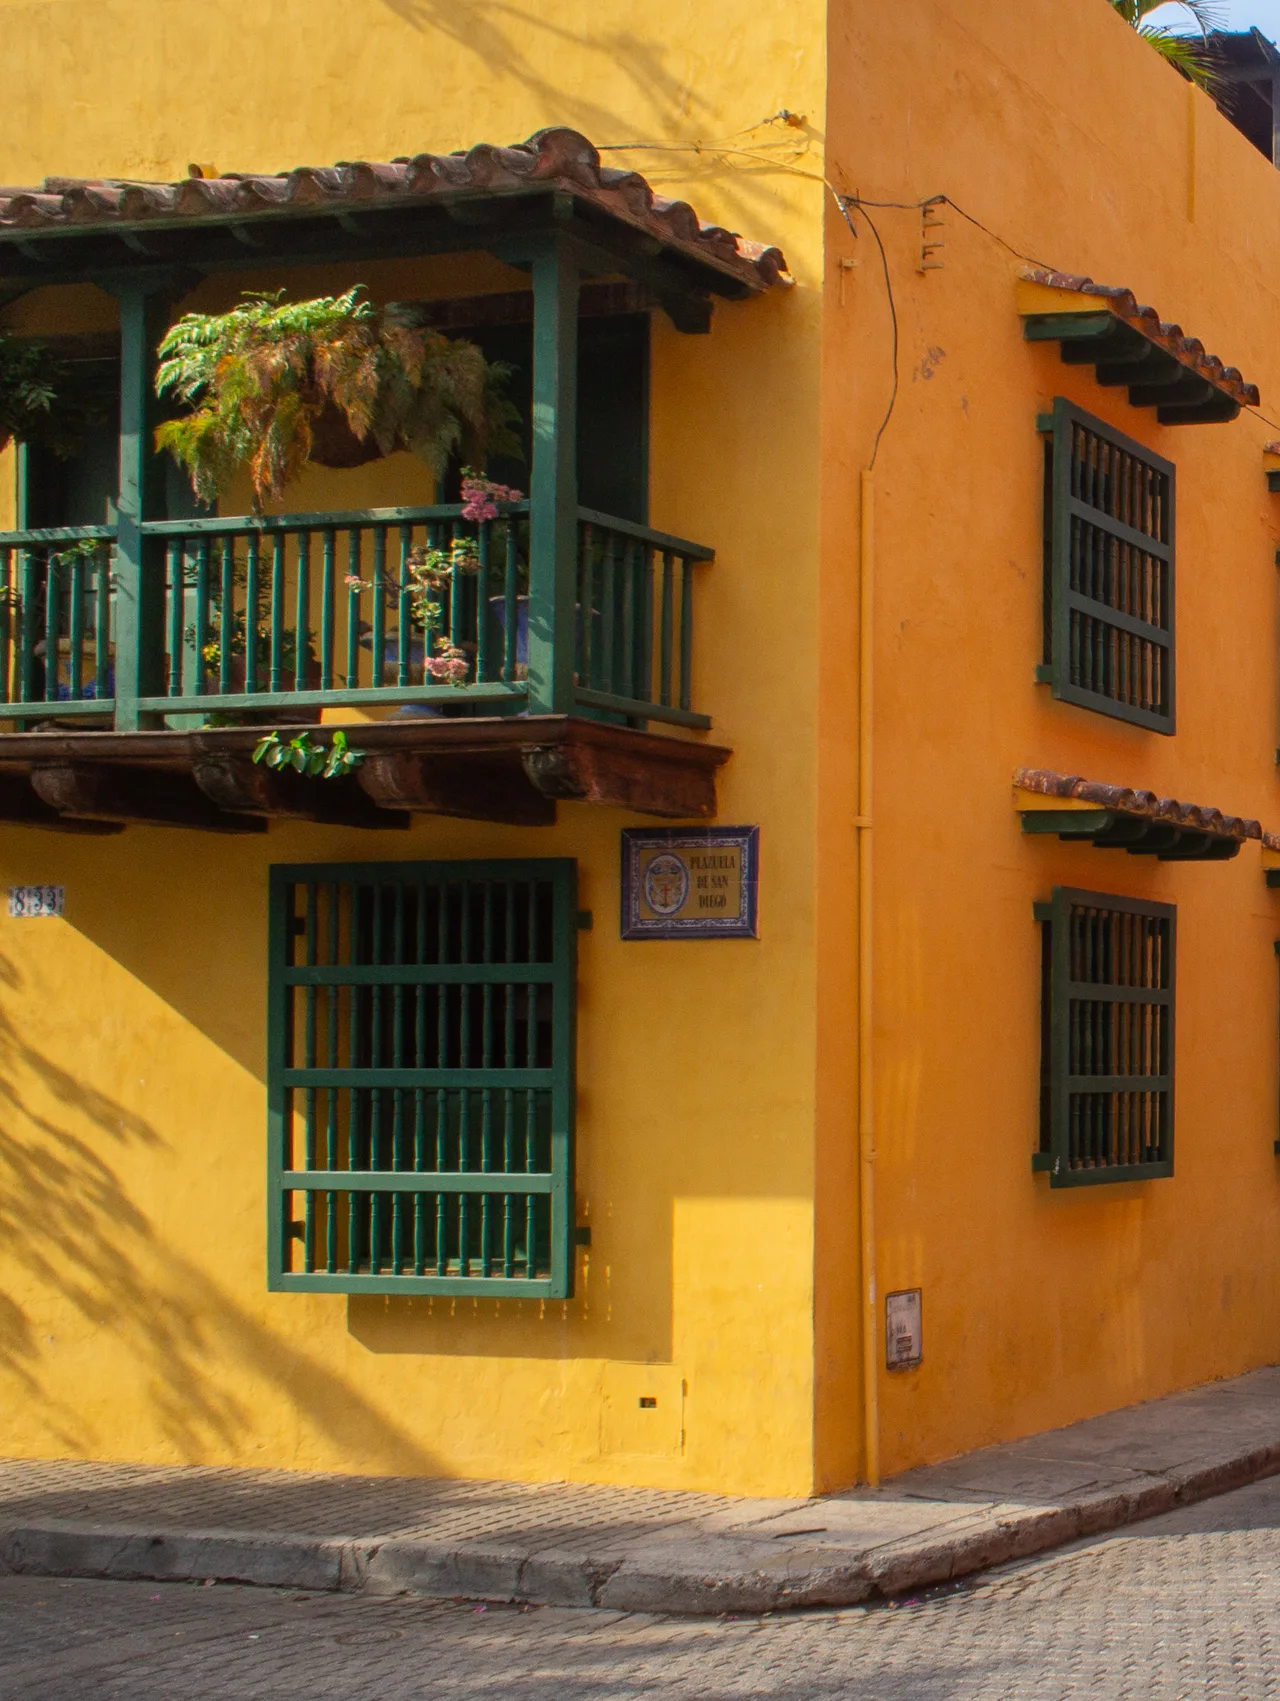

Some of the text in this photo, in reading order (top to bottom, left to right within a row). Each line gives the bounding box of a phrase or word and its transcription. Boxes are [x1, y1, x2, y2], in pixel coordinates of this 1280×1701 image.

[690, 856, 735, 869] PLAZUELA
[697, 876, 728, 889] DE SAN
[15, 890, 56, 911] 833
[699, 894, 727, 908] DIEGO
